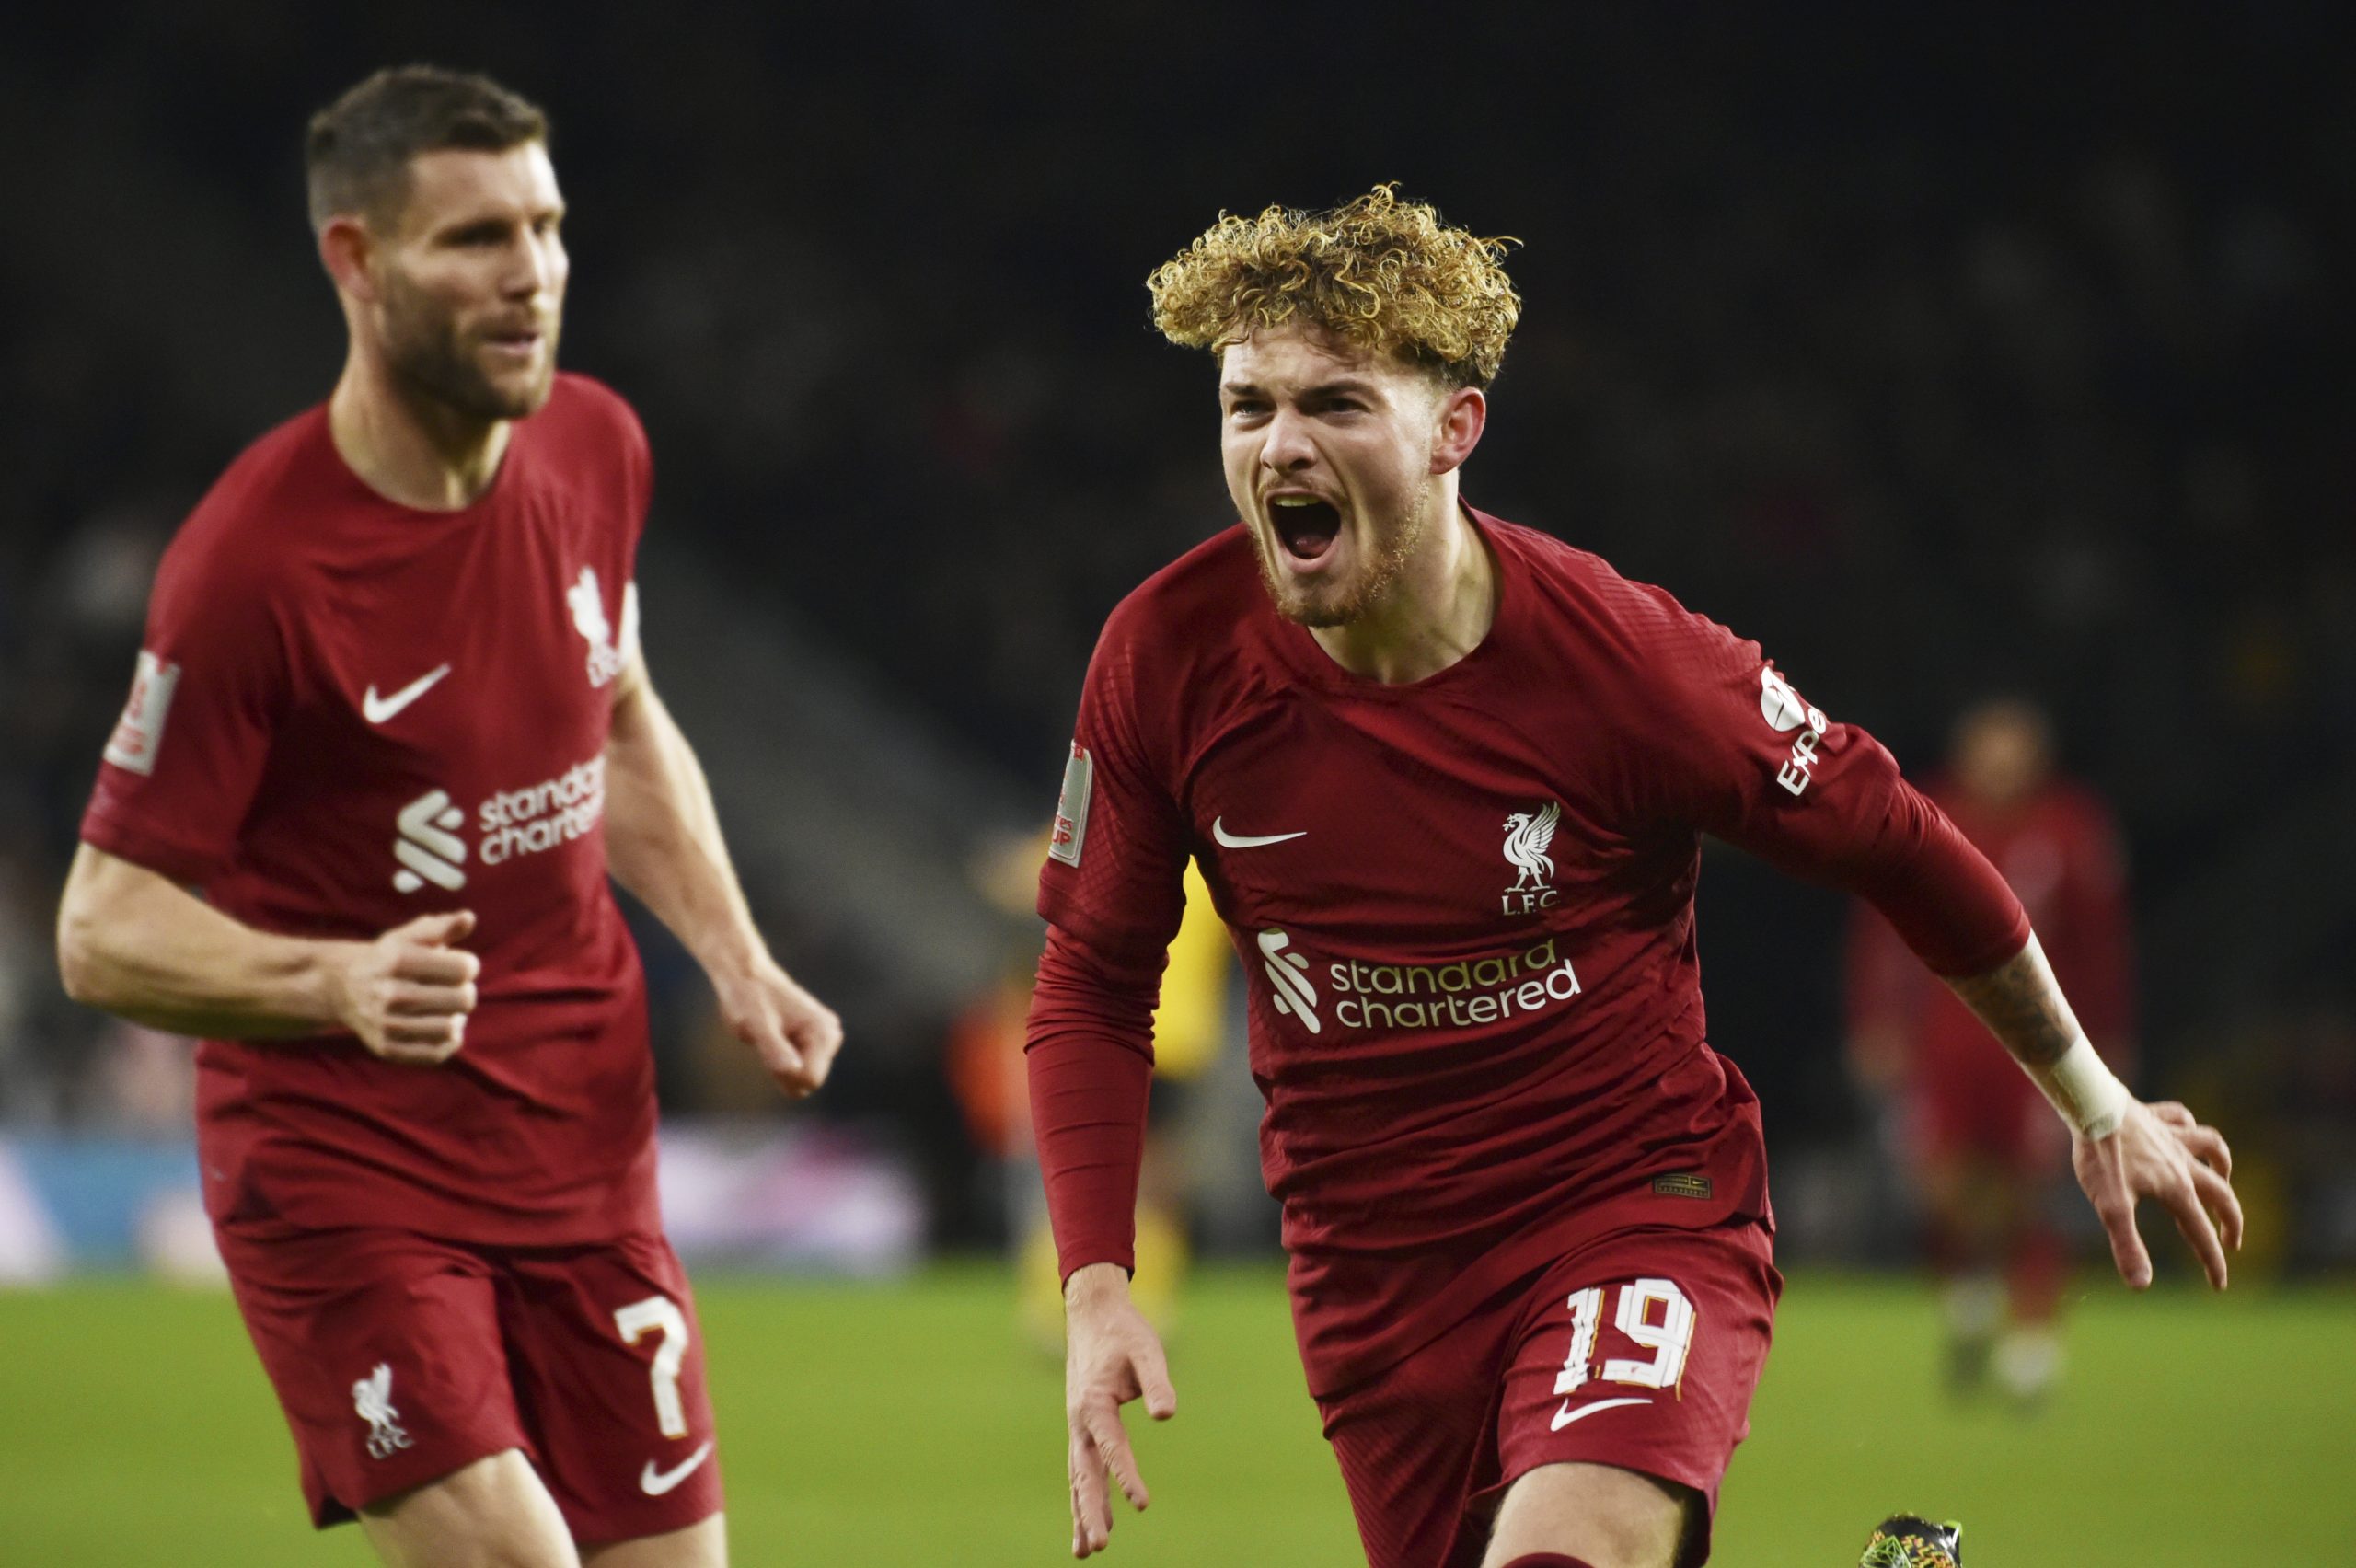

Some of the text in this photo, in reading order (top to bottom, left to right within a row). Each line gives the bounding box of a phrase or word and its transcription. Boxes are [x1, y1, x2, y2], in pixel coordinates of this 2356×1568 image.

[1330, 938, 1556, 994] standard
[1336, 958, 1582, 1029] chartered
[613, 1295, 688, 1440] 7
[1553, 1277, 1697, 1401] 19
